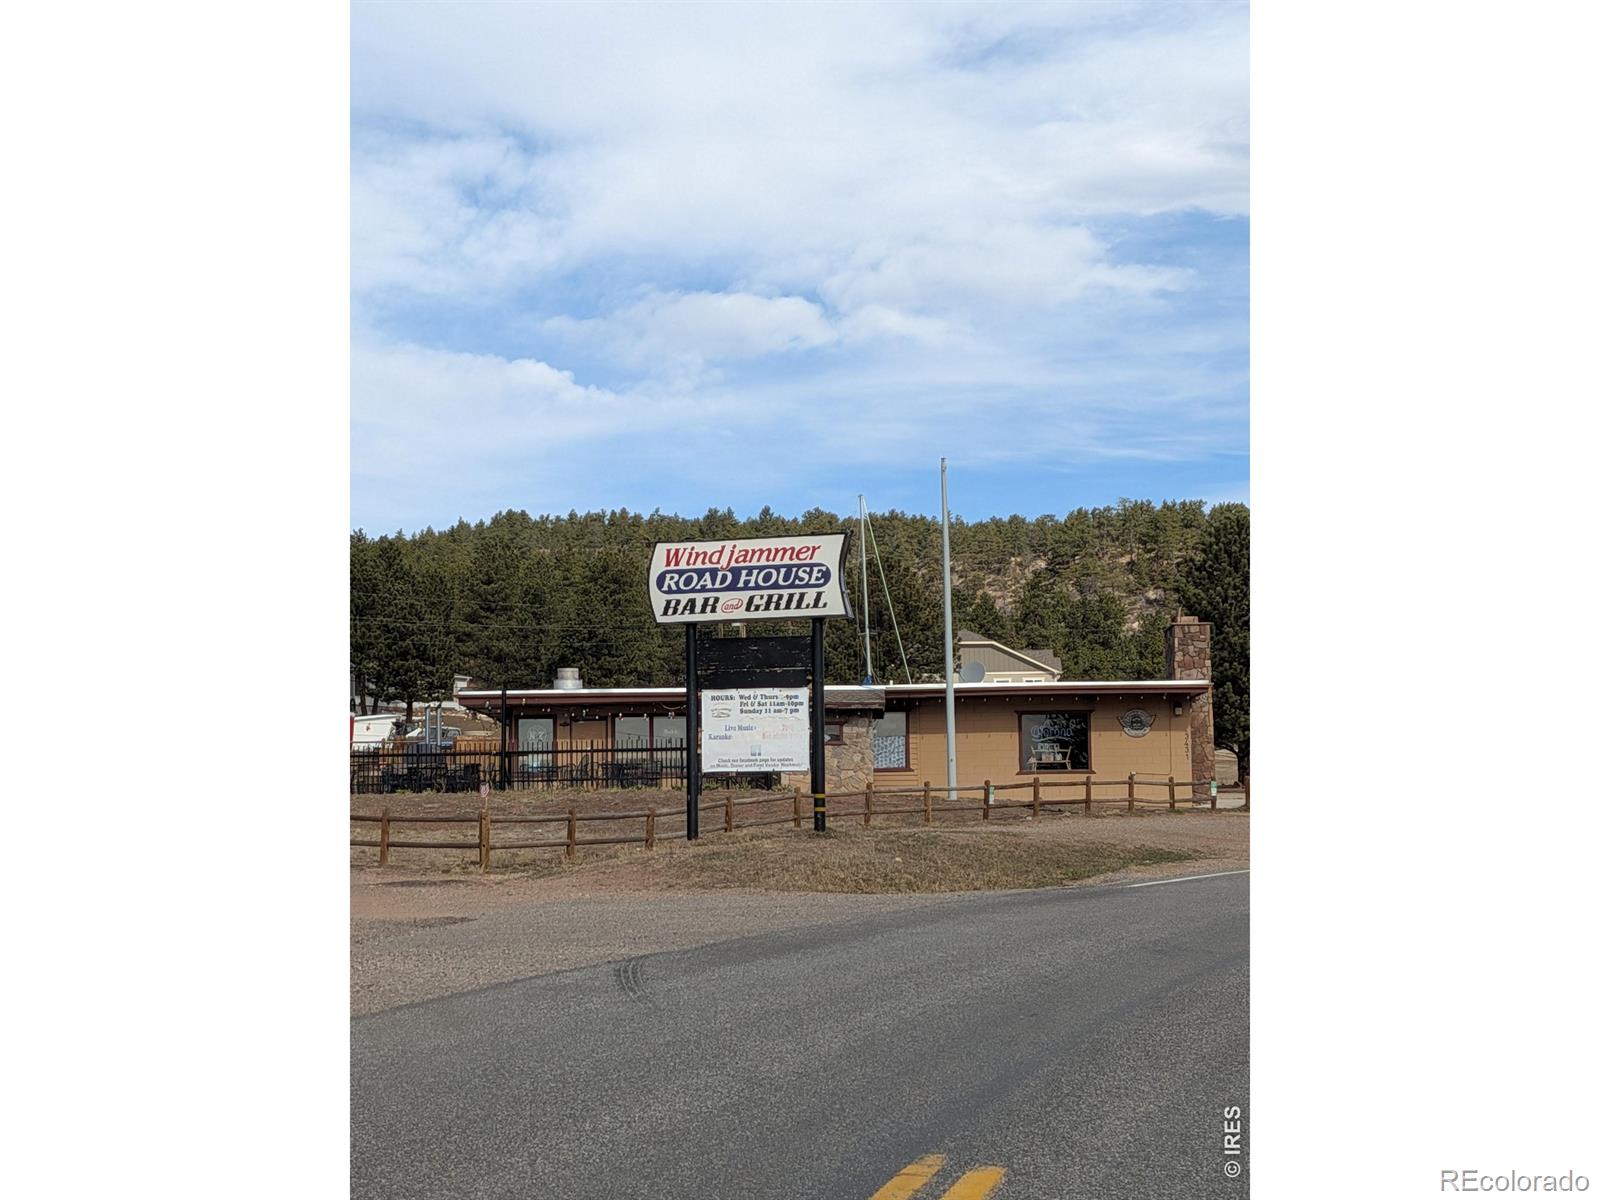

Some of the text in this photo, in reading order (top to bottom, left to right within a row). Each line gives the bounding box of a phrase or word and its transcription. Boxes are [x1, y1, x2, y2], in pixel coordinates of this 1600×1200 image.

[661, 566, 826, 591] ROAD HOUSE
[660, 591, 828, 617] BAR and GRILL
[710, 694, 736, 702] HOURS:
[739, 707, 763, 715] Sunday
